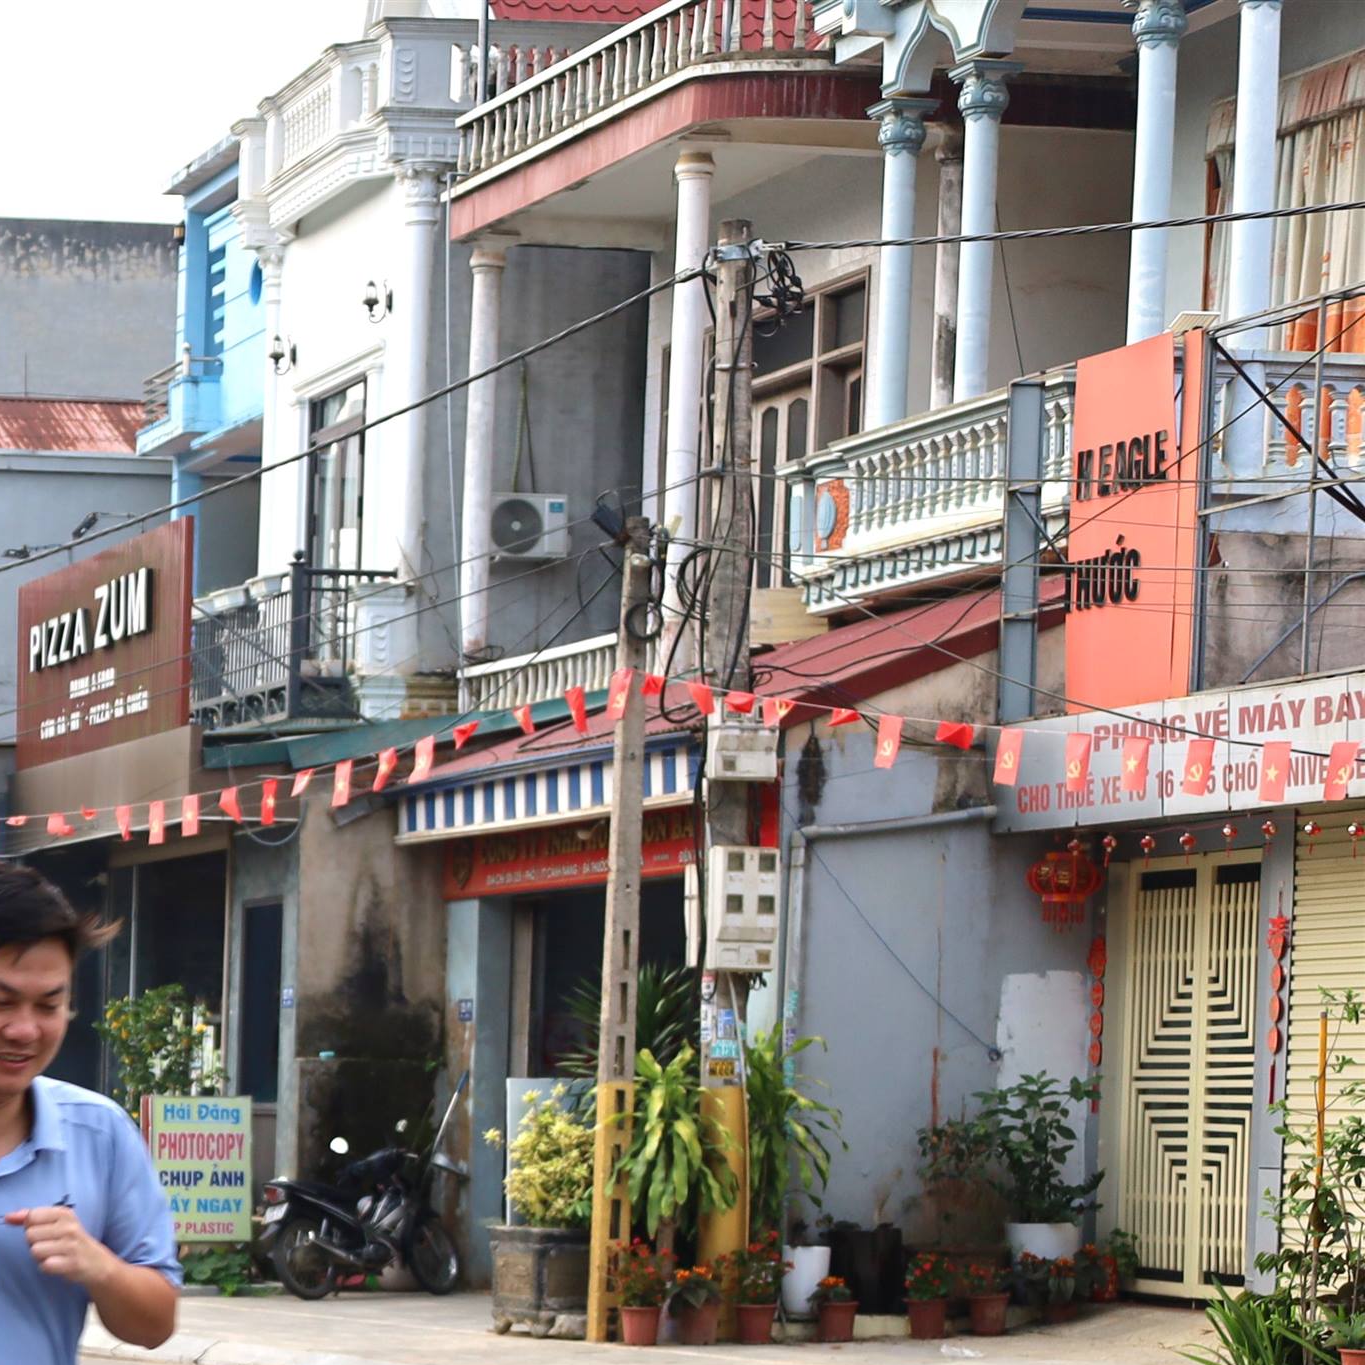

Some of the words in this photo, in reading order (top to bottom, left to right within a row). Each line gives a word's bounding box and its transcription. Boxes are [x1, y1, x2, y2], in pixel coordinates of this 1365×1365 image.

[1098, 429, 1169, 497] EAGLE
[29, 606, 89, 673] PIZZA
[94, 566, 151, 650] ZUM
[1093, 711, 1187, 752] PHÒNG
[1194, 702, 1230, 740] VÉ
[1238, 693, 1306, 736] MÁY
[1016, 785, 1051, 814] CHO
[1101, 775, 1121, 806] XE
[1155, 769, 1174, 799] 16
[157, 1132, 245, 1161] PHOTOCOPY
[159, 1170, 204, 1191] CHỤP
[209, 1164, 245, 1187] ẢNH
[170, 1192, 191, 1213] ẤY
[196, 1198, 243, 1213] NGAY
[185, 1221, 235, 1235] PLASTIC
